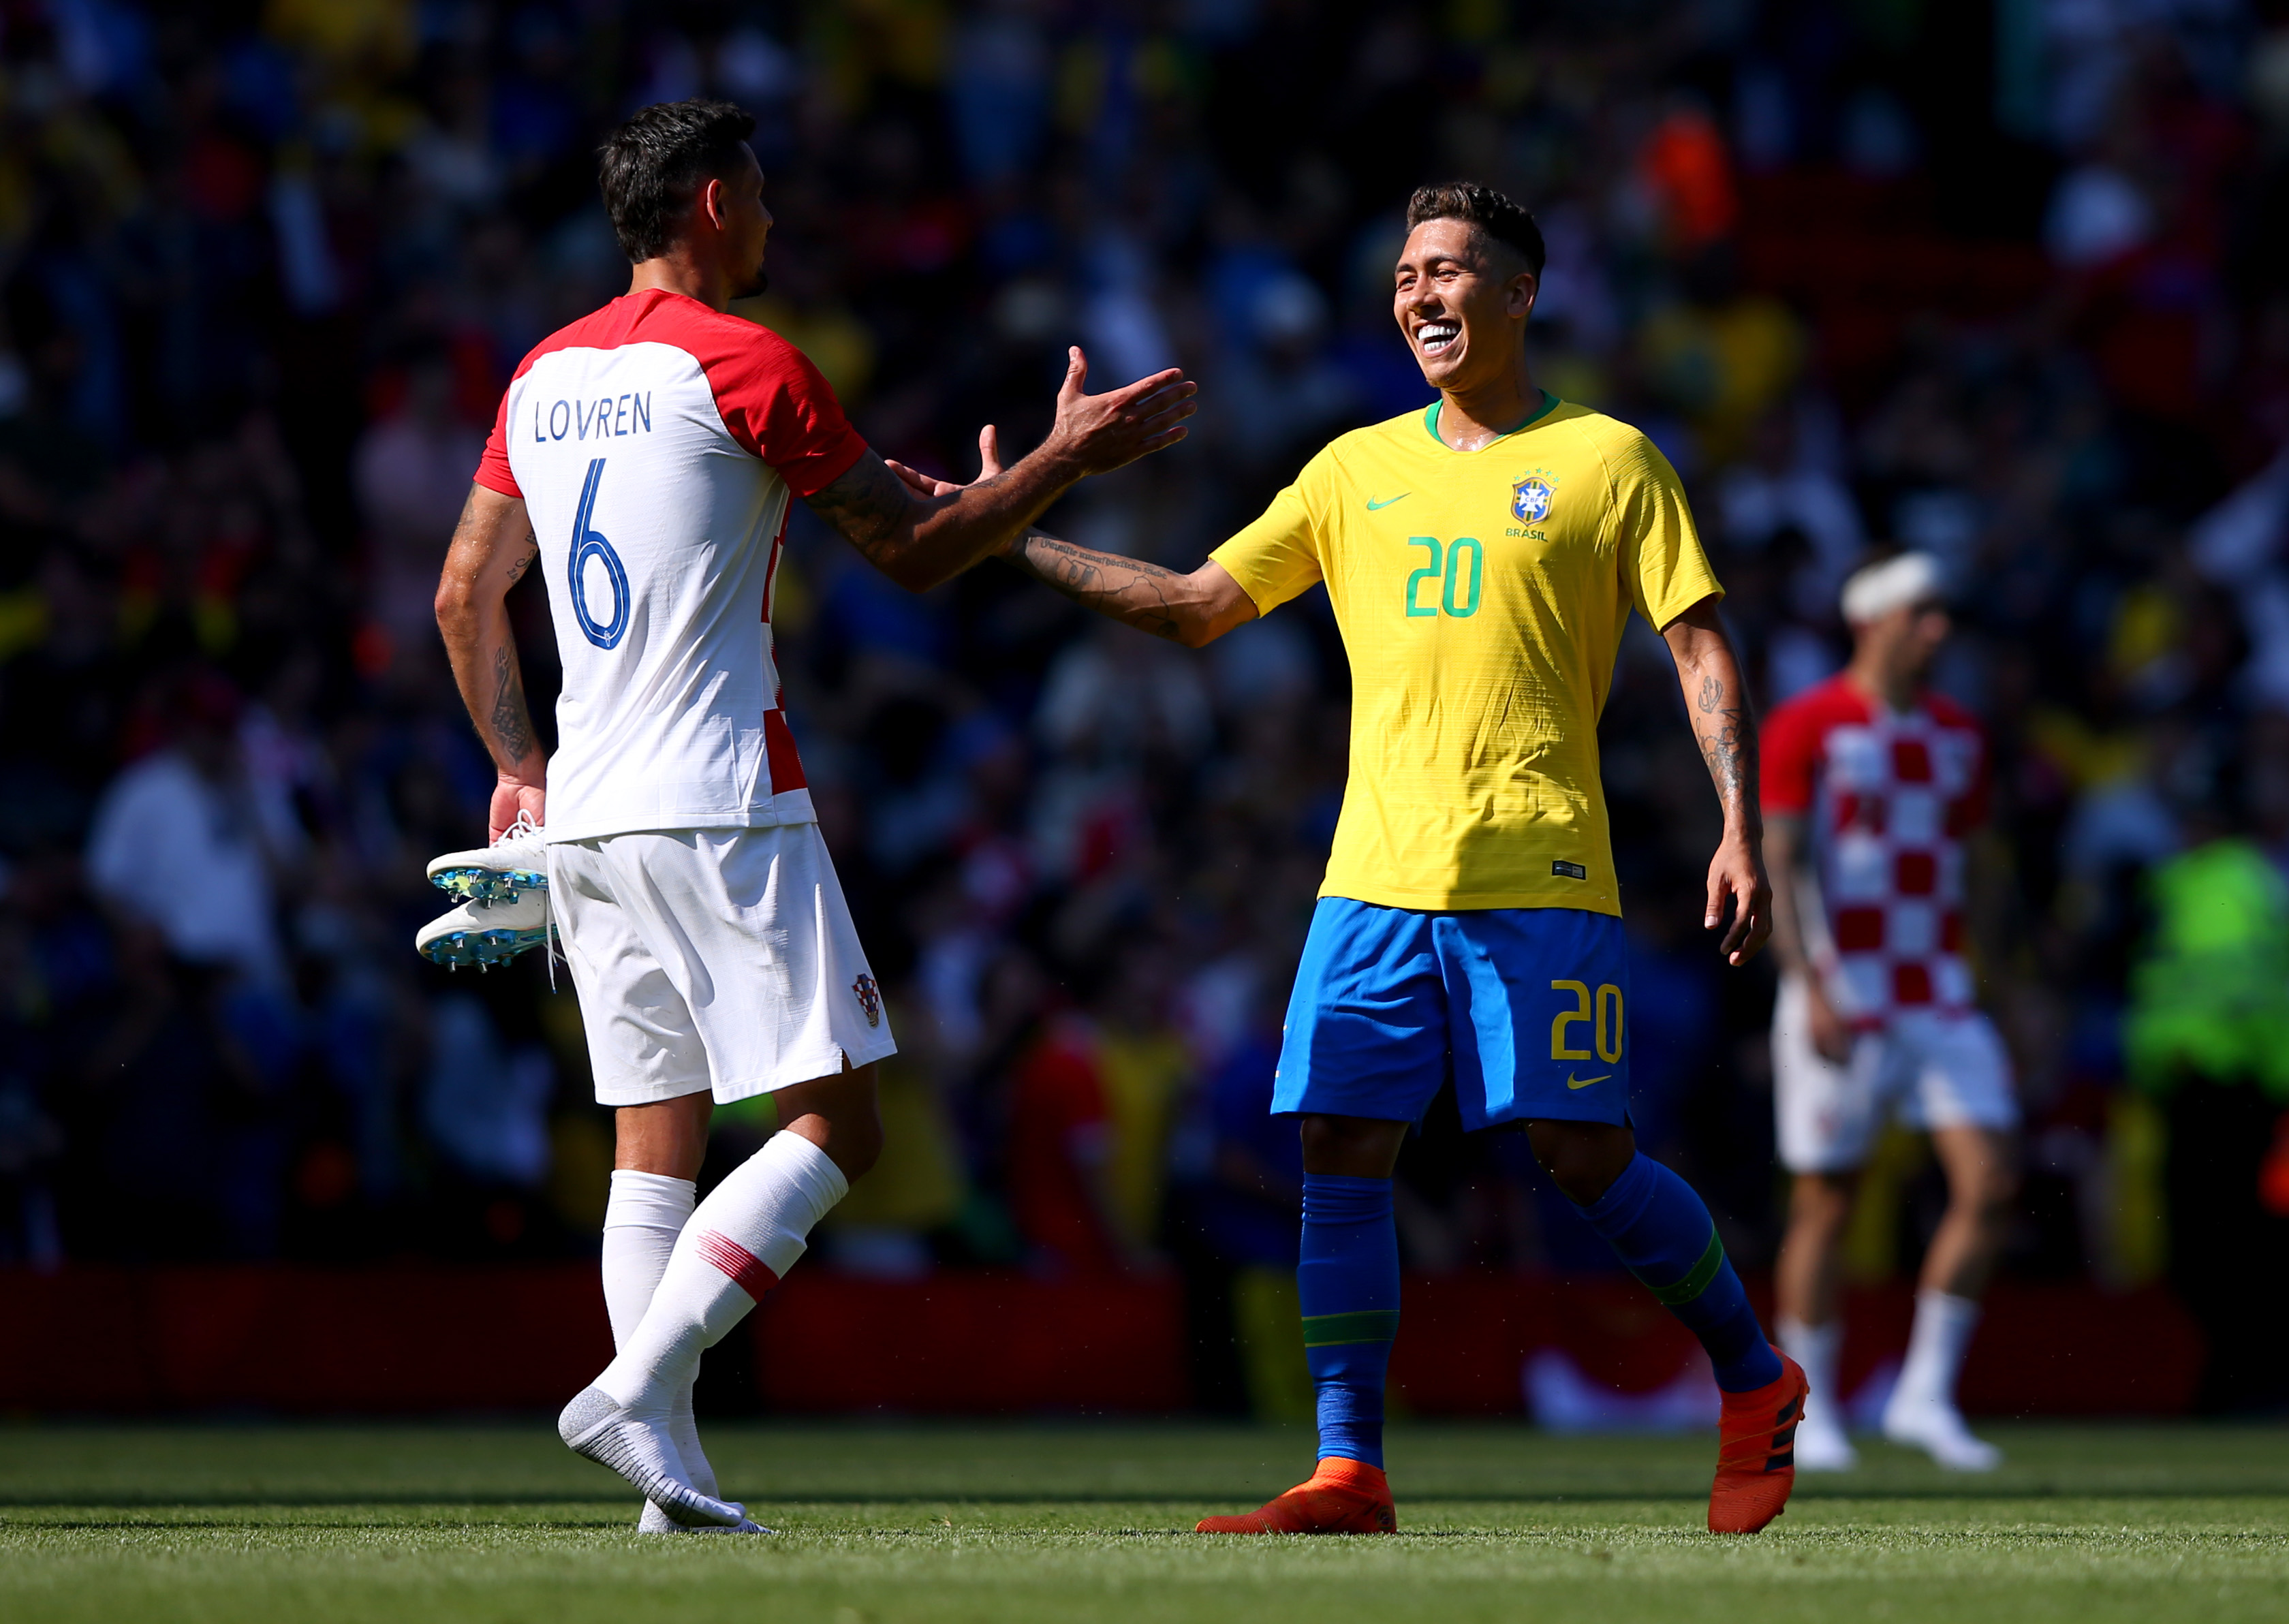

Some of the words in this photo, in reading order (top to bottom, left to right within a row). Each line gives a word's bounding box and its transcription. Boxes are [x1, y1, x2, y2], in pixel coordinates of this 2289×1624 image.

[535, 390, 652, 443] LOVREN
[568, 458, 630, 650] 6
[1506, 528, 1548, 543] BRASIL
[1406, 537, 1482, 618] 20
[1551, 980, 1623, 1064] 20
